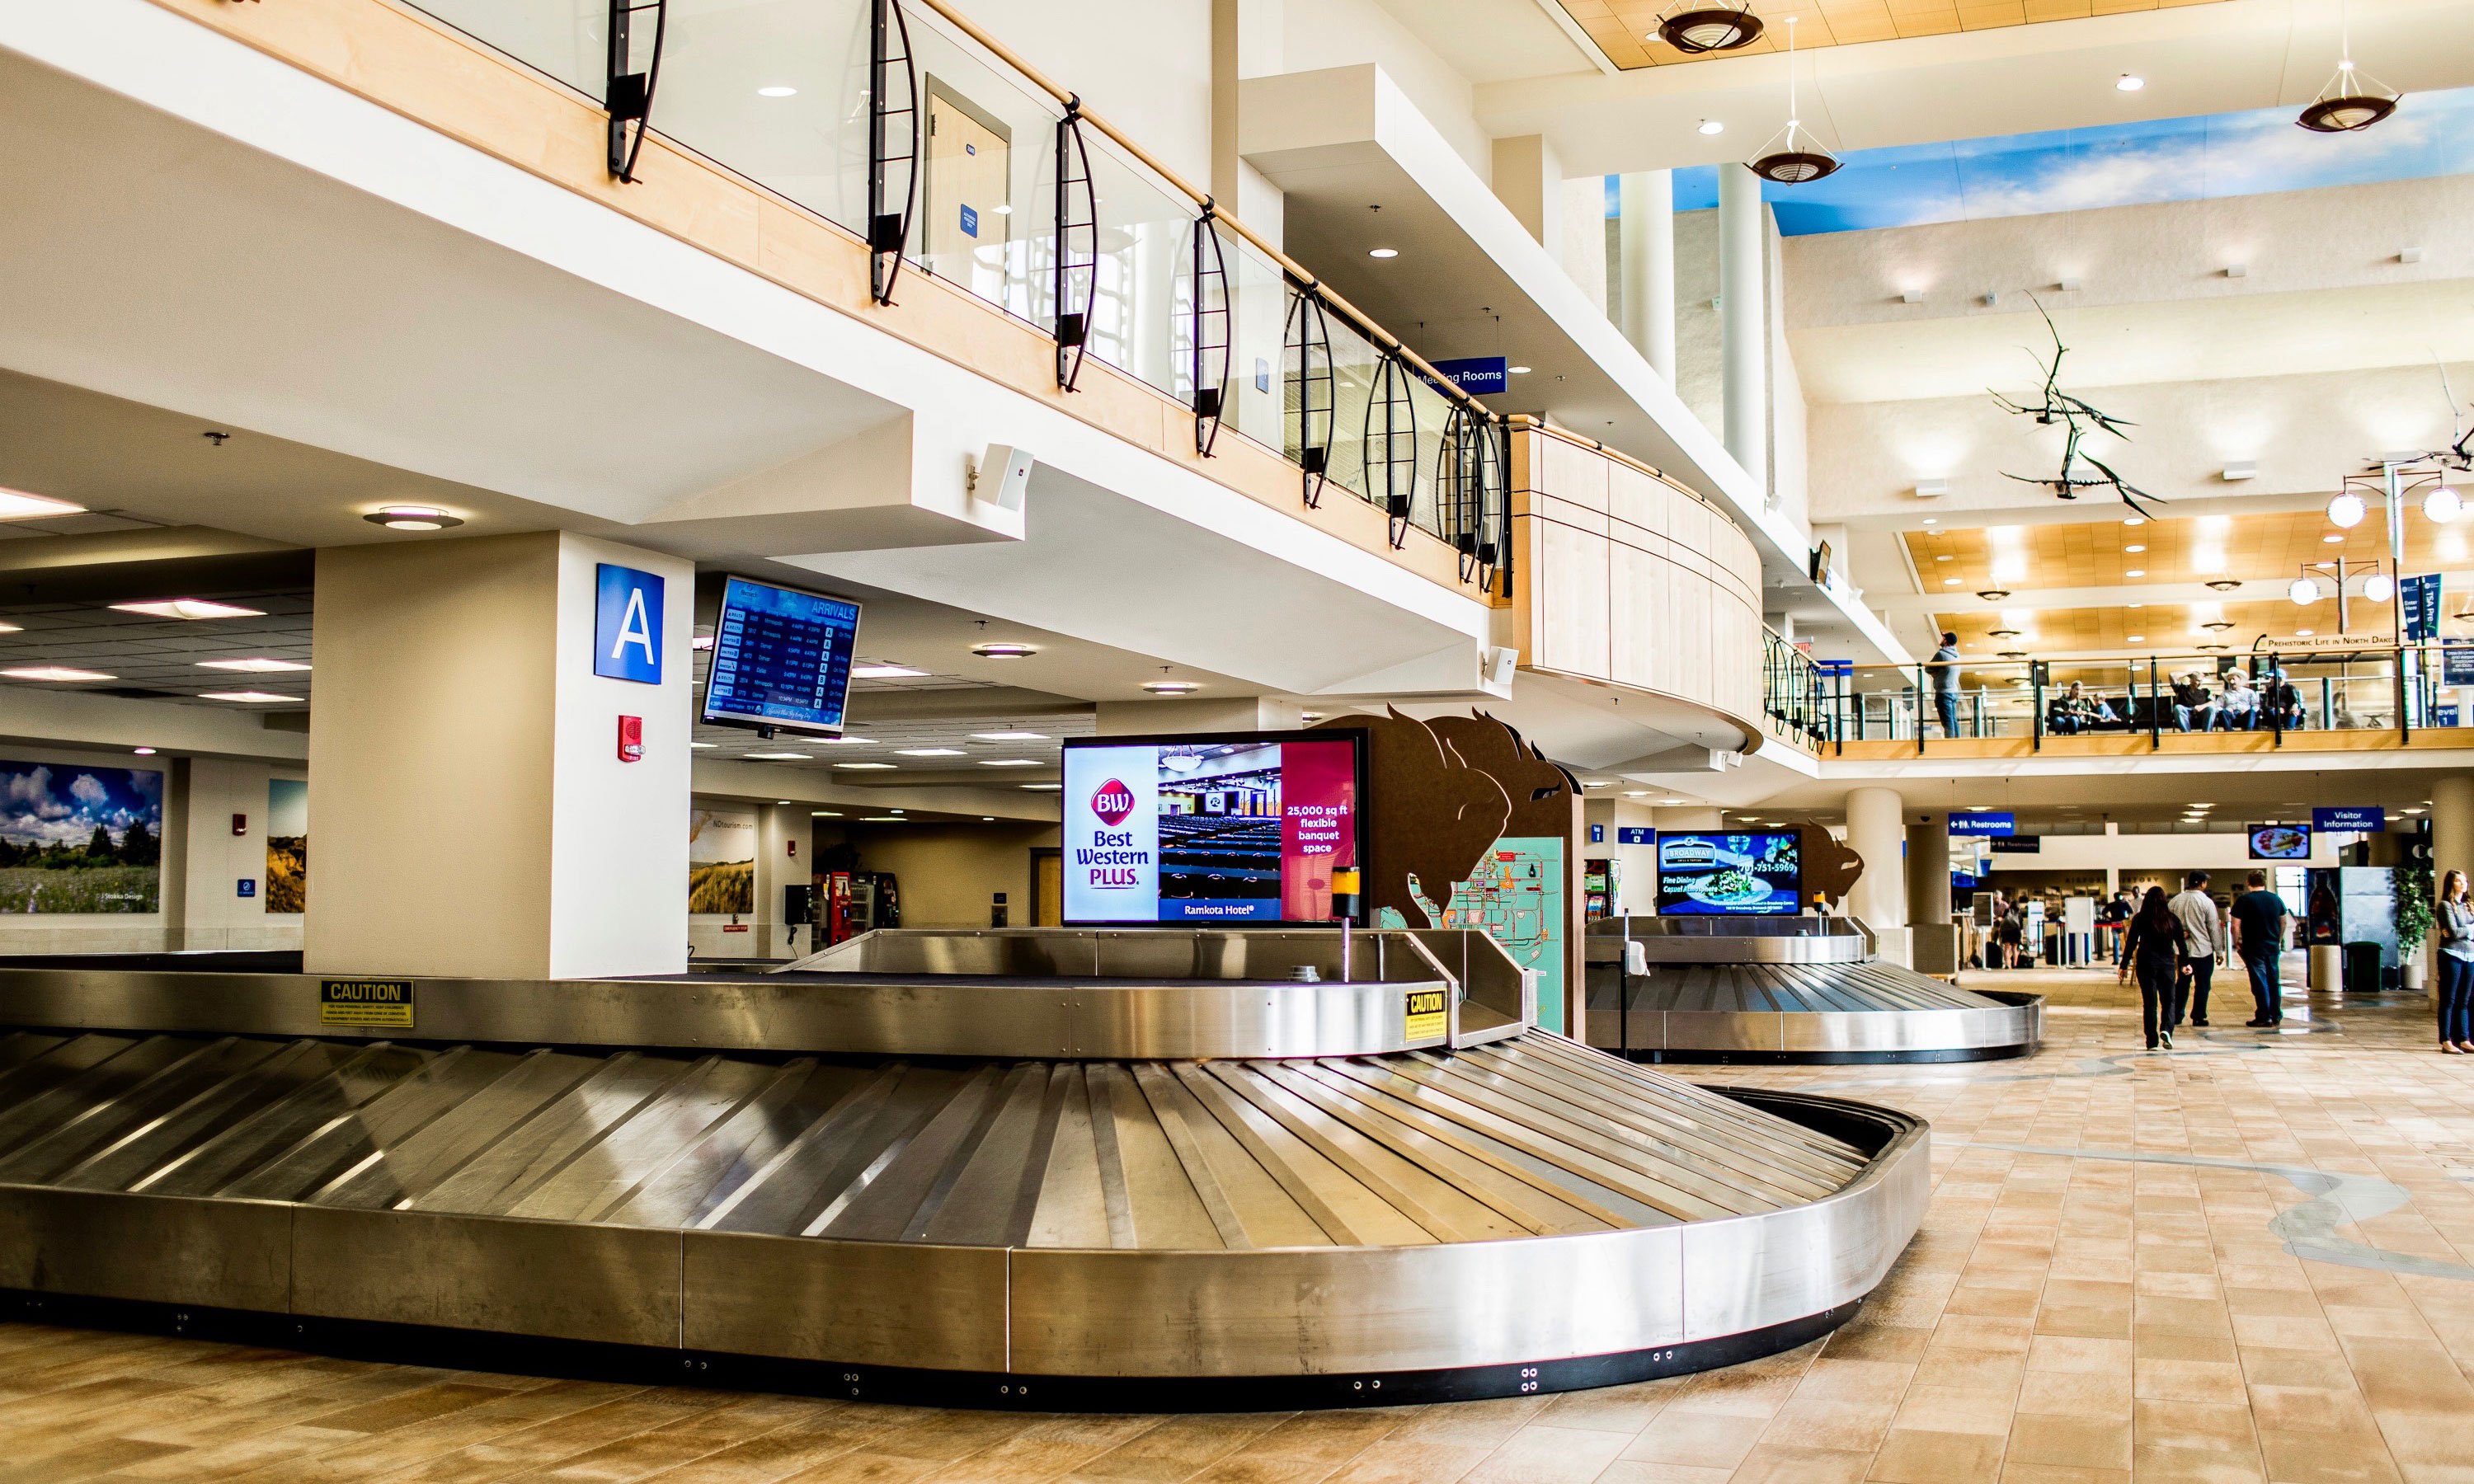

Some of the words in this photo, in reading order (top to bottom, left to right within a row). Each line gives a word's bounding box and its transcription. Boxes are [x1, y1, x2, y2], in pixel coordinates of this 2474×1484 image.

[1463, 371, 1502, 381] Rooms
[811, 601, 855, 620] ARRIVALS
[611, 588, 655, 665] A
[2439, 707, 2458, 716] evel
[1287, 805, 1324, 816] 25,000
[1325, 807, 1338, 817] sq
[1338, 805, 1348, 815] ft
[1300, 818, 1337, 828] flexible
[1971, 820, 2011, 829] Restrooms
[1094, 830, 1133, 847] Best
[1298, 830, 1340, 842] banquet
[1303, 843, 1332, 854] space
[1669, 849, 1710, 858] BROADWAY
[1077, 848, 1149, 865] Western
[1740, 863, 1794, 872] 701-751-5969
[1677, 876, 1696, 885] Dining
[1683, 885, 1718, 894] Atmosphere
[1184, 905, 1223, 915] Ramkota
[331, 984, 401, 1001] CAUTION
[1411, 993, 1442, 1013] CAUTION
